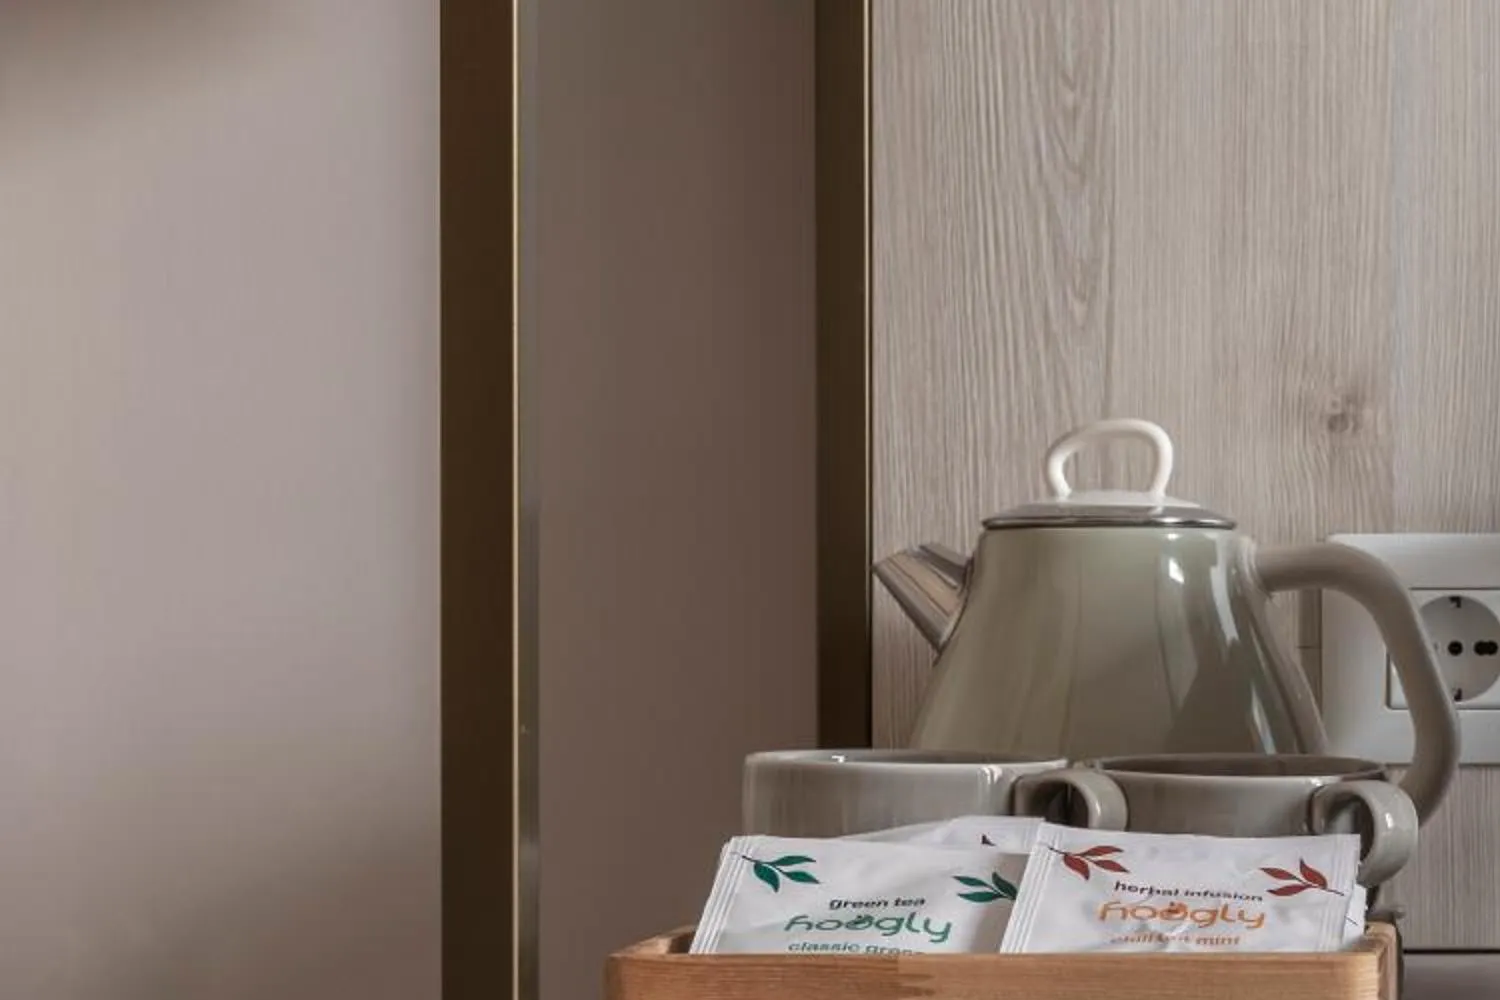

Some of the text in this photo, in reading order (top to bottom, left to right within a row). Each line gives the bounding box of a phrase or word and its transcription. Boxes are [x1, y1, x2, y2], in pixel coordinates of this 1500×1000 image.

[1114, 880, 1179, 898] herbal
[829, 897, 925, 911] green tea
